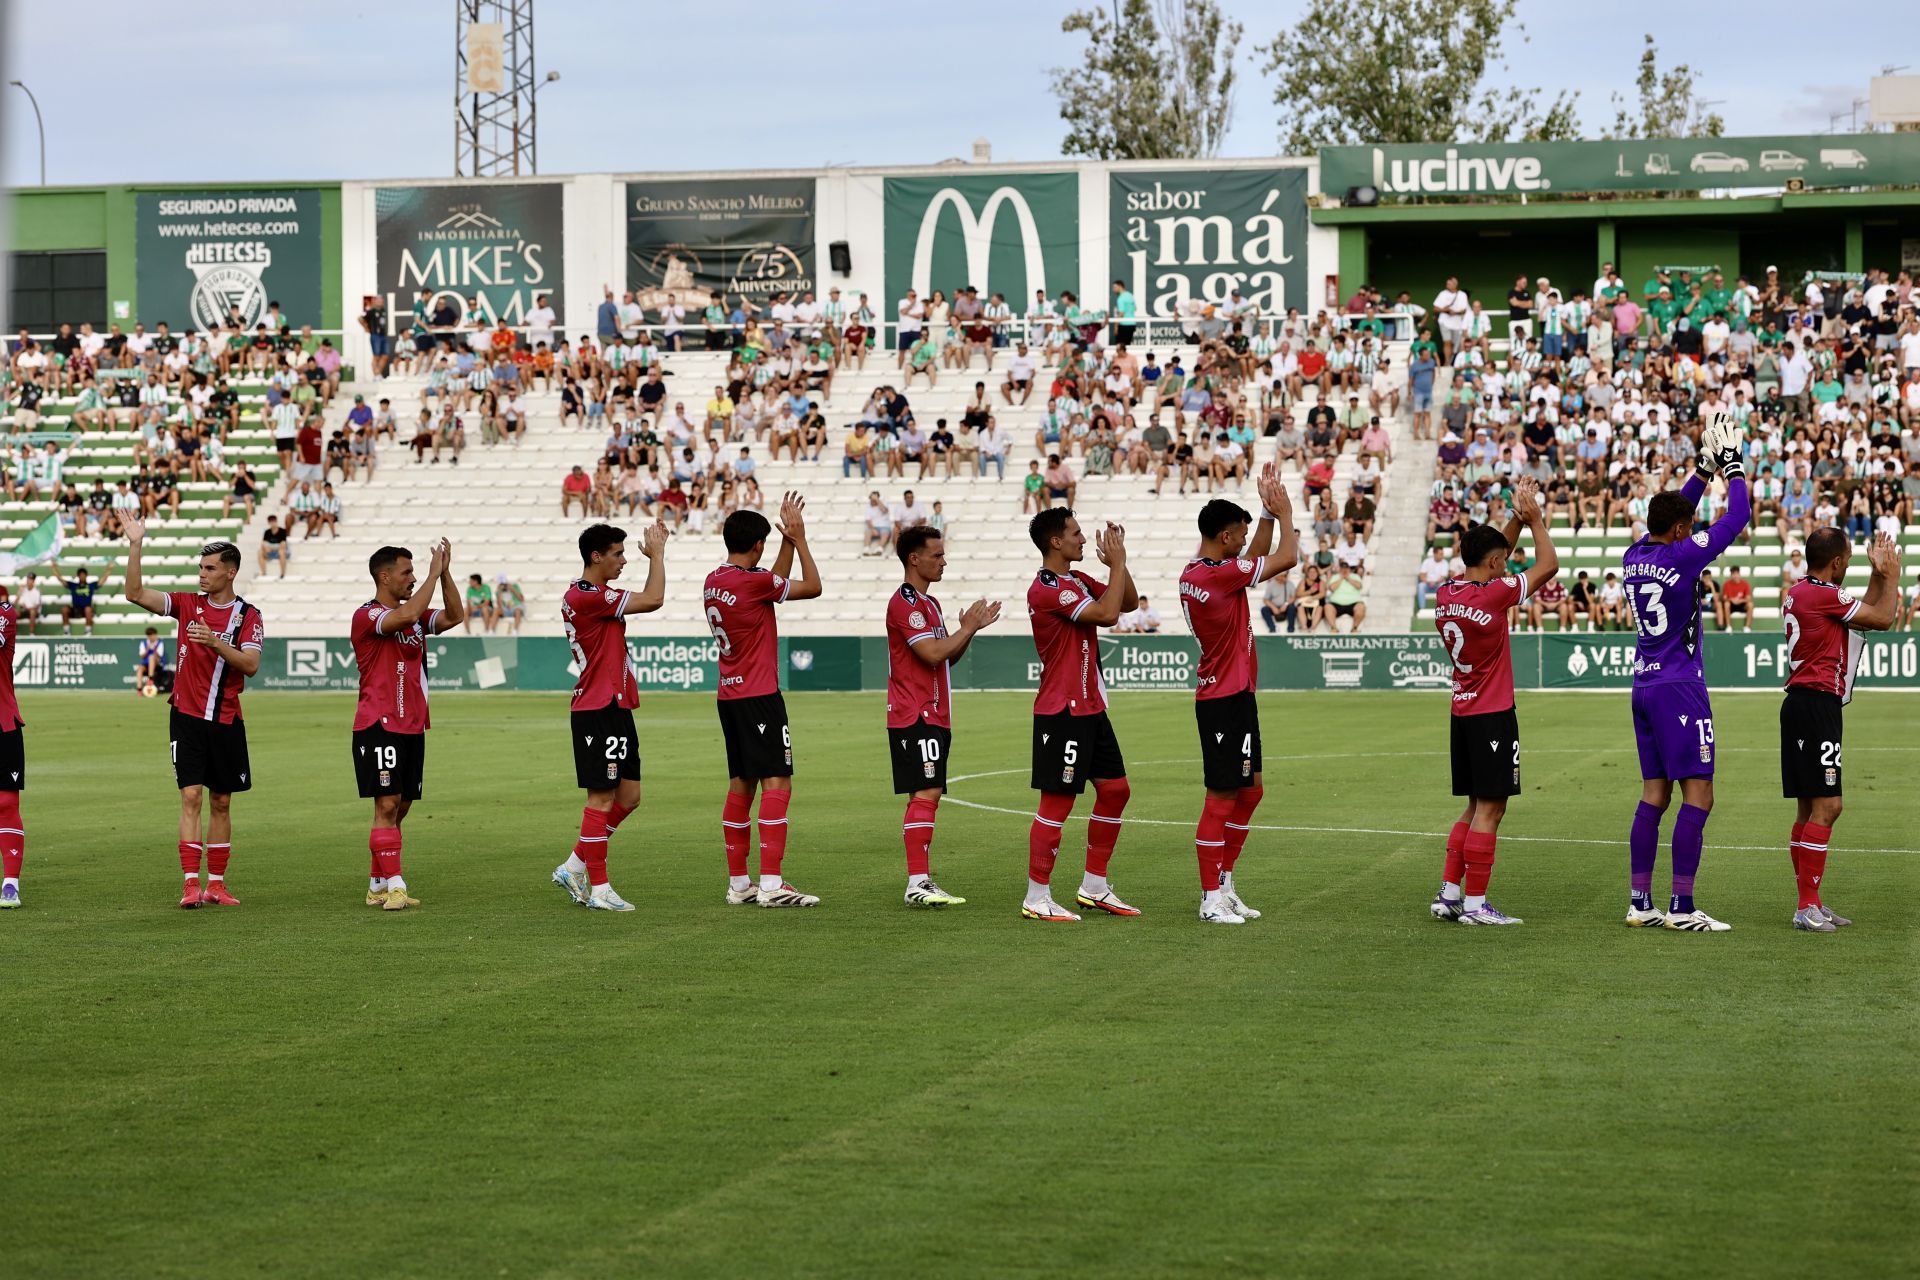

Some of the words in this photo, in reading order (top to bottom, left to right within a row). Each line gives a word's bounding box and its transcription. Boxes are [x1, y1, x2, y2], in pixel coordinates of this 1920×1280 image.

[159, 199, 237, 215] SEGURIDAD
[238, 198, 297, 213] PRIVADA
[1127, 182, 1206, 211] sabor
[158, 221, 299, 237] www.hetecse.com
[418, 229, 520, 241] INMOBILIARIA
[1127, 216, 1150, 242] a
[191, 242, 265, 262] HETECSE
[398, 240, 545, 288] MIKE'S
[751, 253, 786, 278] 75
[727, 275, 812, 294] Aniversario
[1637, 563, 1681, 587] GARCÍA
[1446, 603, 1493, 626] JURADO
[1625, 582, 1668, 637] 13
[707, 606, 732, 657] 6
[55, 643, 86, 655] HOTEL
[1123, 647, 1189, 665] Horno
[1443, 620, 1473, 674] 2
[55, 654, 118, 666] ANTEQUERA
[55, 665, 84, 677] HILLS
[1102, 667, 1189, 686] querano
[782, 724, 791, 748] 6
[1695, 718, 1714, 745] 13
[605, 735, 628, 760] 23
[917, 738, 940, 762] 10
[1063, 739, 1078, 765] 5
[1241, 732, 1252, 758] 4
[1512, 740, 1520, 765] 2
[1820, 741, 1842, 767] 22
[374, 745, 397, 770] 19
